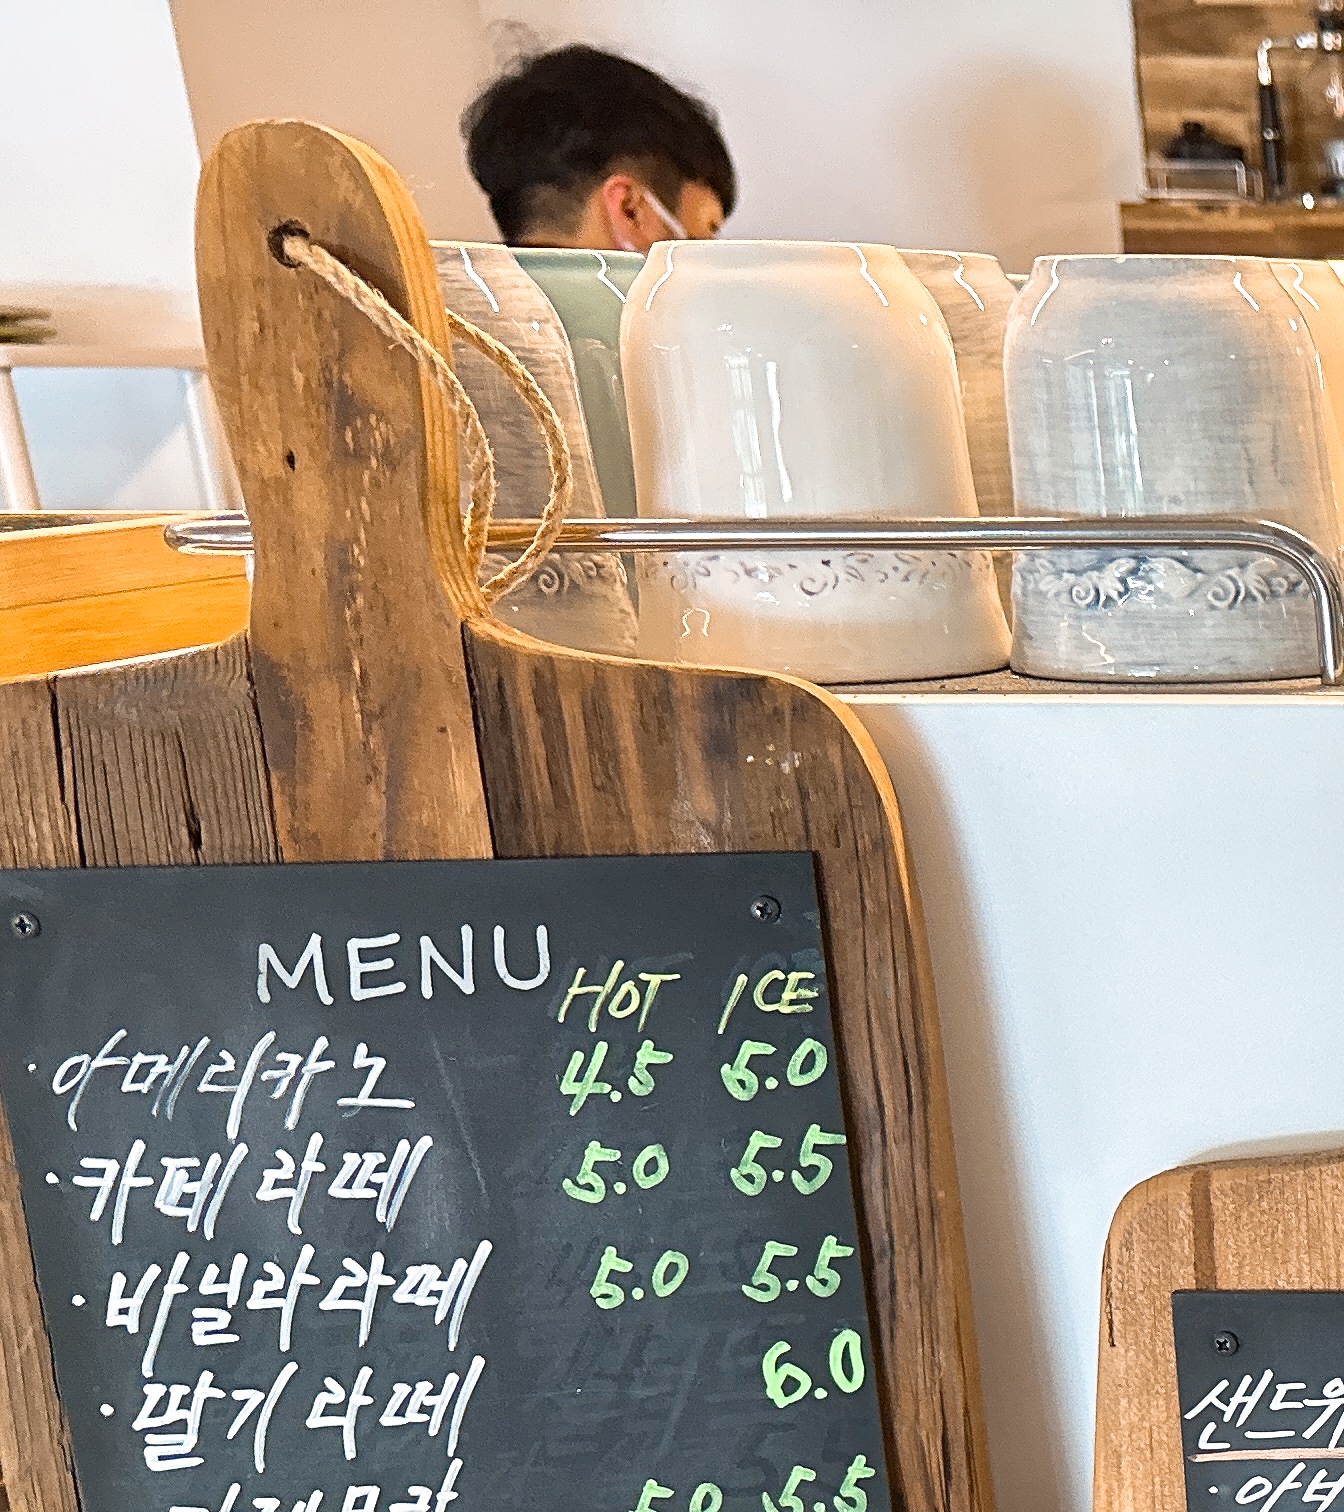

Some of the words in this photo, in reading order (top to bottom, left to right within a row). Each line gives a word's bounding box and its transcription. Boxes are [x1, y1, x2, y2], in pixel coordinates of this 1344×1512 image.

[257, 924, 550, 1005] MENU
[558, 960, 680, 1032] HOT
[718, 970, 818, 1034] ICE
[53, 1029, 415, 1139] 아메리카노
[560, 1040, 673, 1116] 4.5
[721, 1038, 827, 1100] 5.0
[562, 1141, 669, 1203] 5.0
[730, 1124, 846, 1196] 5.5
[590, 1246, 688, 1309] 5.0
[742, 1235, 854, 1302] 5.5
[763, 1329, 864, 1408] 6.0
